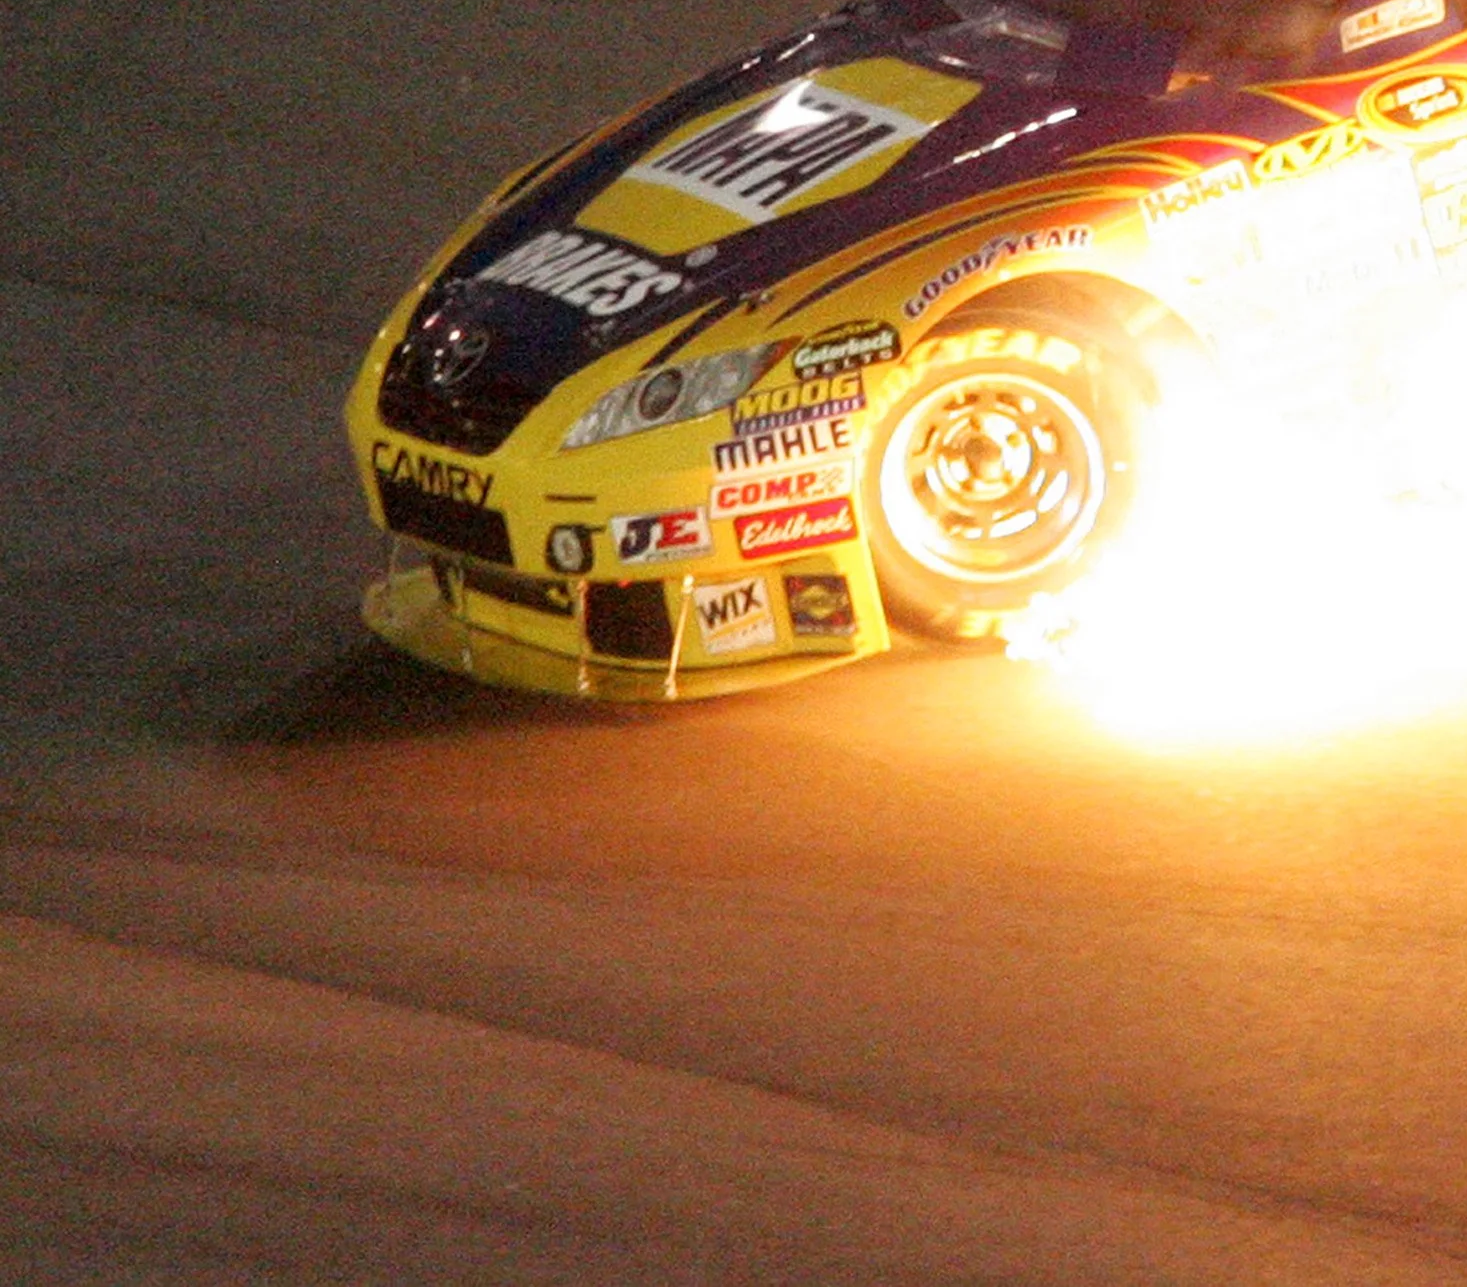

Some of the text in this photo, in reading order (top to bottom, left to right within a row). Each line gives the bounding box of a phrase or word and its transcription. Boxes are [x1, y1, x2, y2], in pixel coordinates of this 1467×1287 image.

[651, 90, 898, 209] NAPA
[902, 226, 1090, 320] GOODYEAR
[734, 370, 864, 422] MOOG
[714, 417, 850, 474] MAHLE
[371, 440, 494, 509] CAMRY
[717, 470, 817, 511] COMP
[618, 511, 699, 560] JE
[739, 504, 853, 550] Edelbrock
[699, 583, 762, 630] WIX
